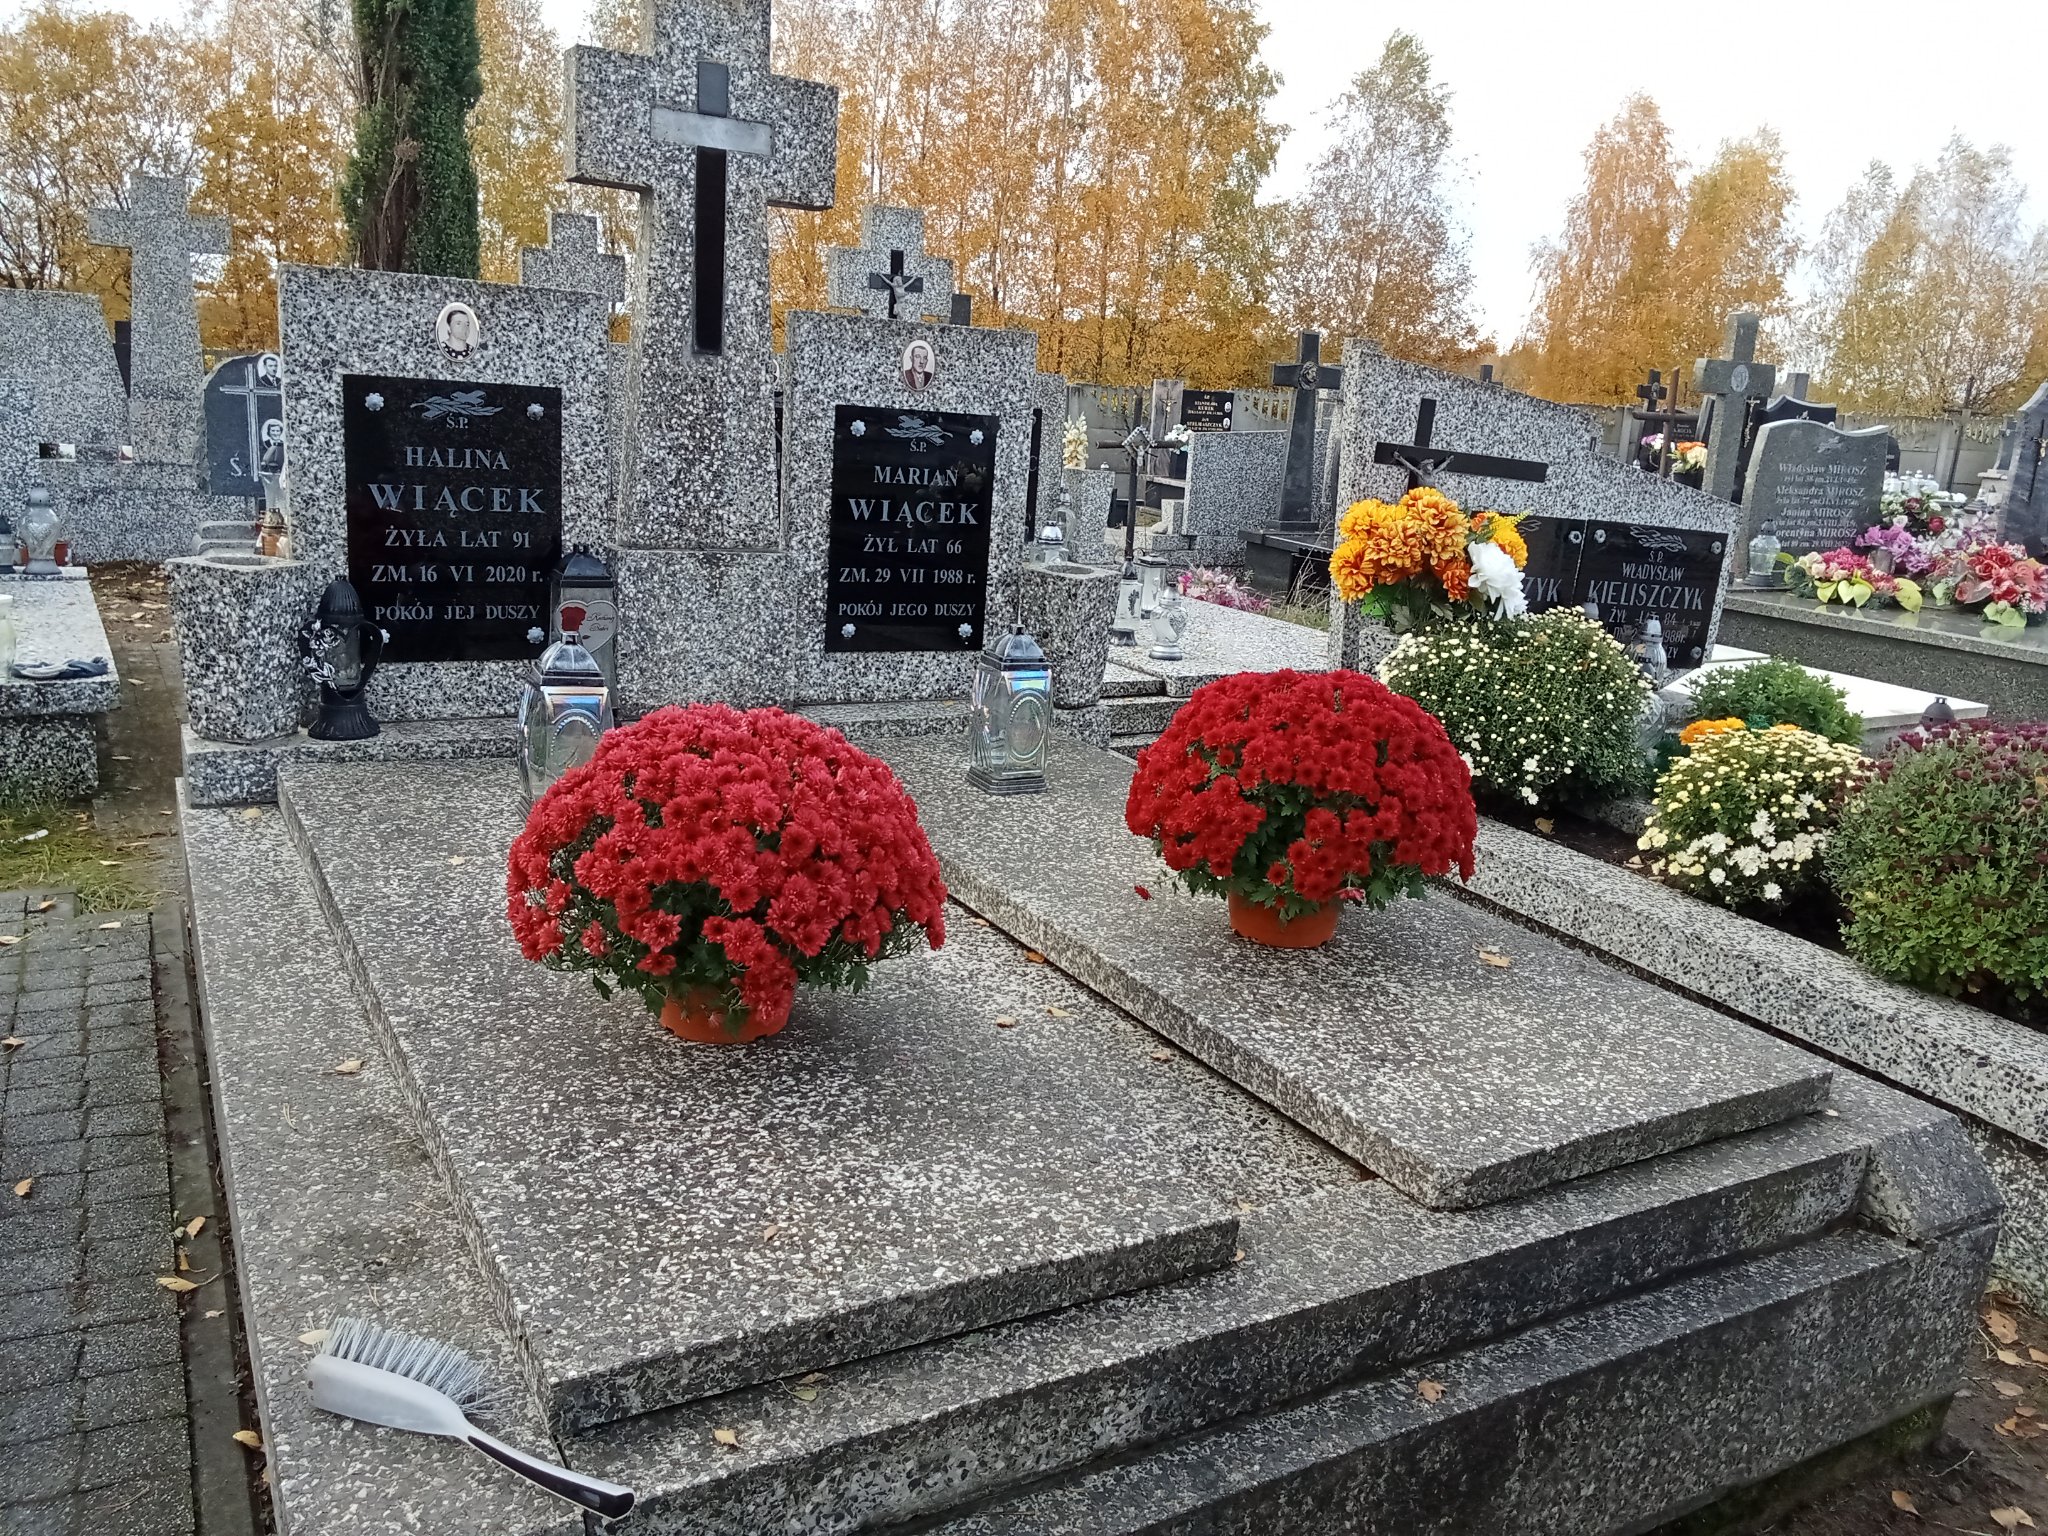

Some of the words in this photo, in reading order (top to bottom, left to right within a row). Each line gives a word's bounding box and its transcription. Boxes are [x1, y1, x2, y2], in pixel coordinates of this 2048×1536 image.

[404, 446, 510, 470] HALINA
[872, 465, 959, 487] MARIAN
[367, 483, 547, 518] WIĄCEK
[848, 498, 979, 528] WIĄCEK
[1812, 507, 1854, 518] MIROSZ
[384, 525, 448, 547] ŻYŁA
[460, 530, 502, 548] LAT
[512, 531, 531, 548] 91
[863, 533, 899, 553] ŻYŁ
[906, 537, 939, 554] LAT
[946, 539, 962, 554] 66
[1816, 528, 1858, 539] MIROSZ
[371, 564, 413, 583] ZM.
[418, 564, 438, 583] 16
[449, 565, 474, 583] VI
[485, 565, 526, 583] 2020
[531, 569, 544, 583] r.
[839, 567, 870, 583] ZM.
[874, 567, 891, 583] 29
[899, 568, 925, 583] VII
[933, 569, 963, 584] 1988
[967, 572, 976, 584] r.
[1622, 563, 1685, 581] WŁADYSŁAW
[1588, 580, 1706, 610] KIELISZCZYK
[375, 602, 434, 620] POKÓJ
[443, 605, 475, 620] JEJ
[485, 605, 541, 620] DUSZY
[838, 600, 883, 617] POKÓJ
[890, 602, 928, 617] JEGO
[934, 603, 977, 617] DUSZY
[1608, 604, 1628, 624] ŻYŁ
[1663, 612, 1678, 626] 84
